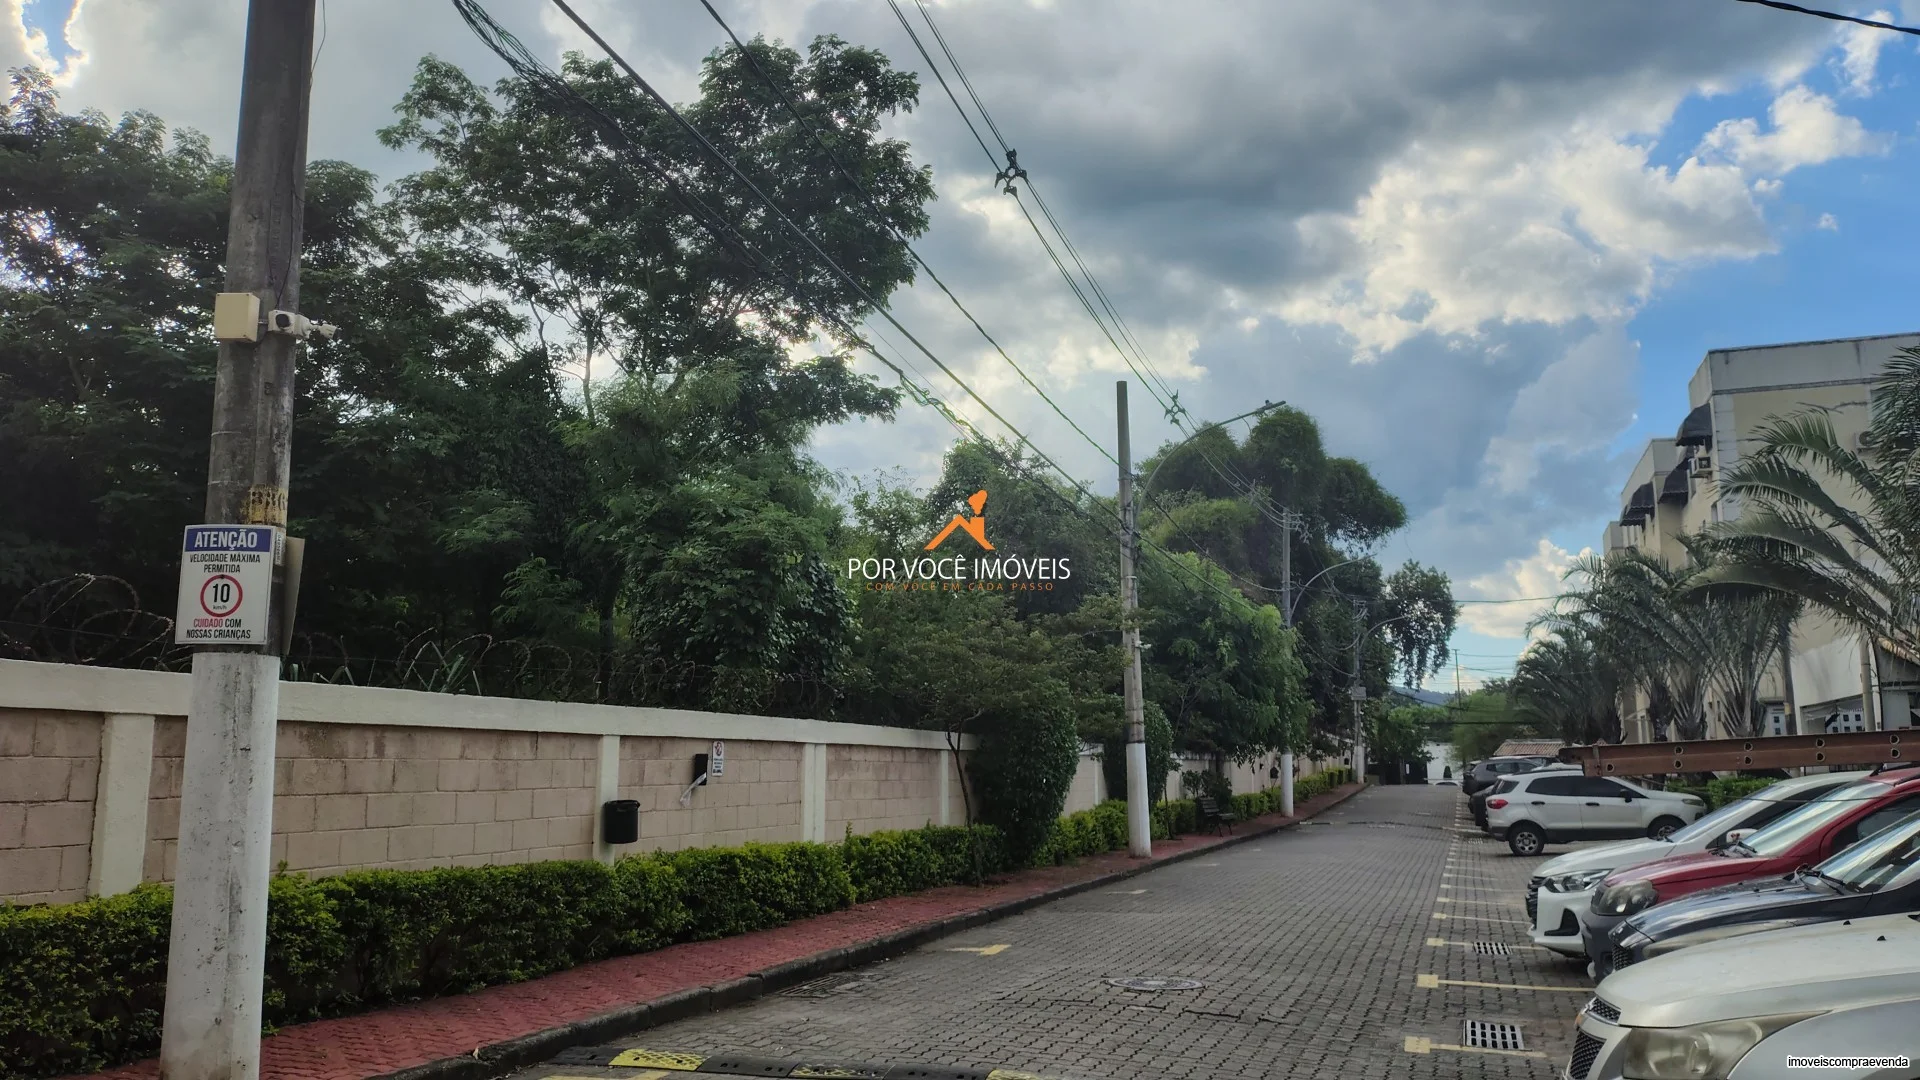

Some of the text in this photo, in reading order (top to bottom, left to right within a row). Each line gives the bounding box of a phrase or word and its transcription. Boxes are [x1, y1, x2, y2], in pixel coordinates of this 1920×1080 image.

[194, 529, 258, 551] ATENÇÃO
[190, 553, 228, 563] VELOCIDADE
[203, 564, 241, 573] PERMITIDA
[212, 583, 231, 603] 10
[193, 618, 242, 628] CUIDADO COM
[186, 629, 251, 640] NOSSAS CRIANÇAS
